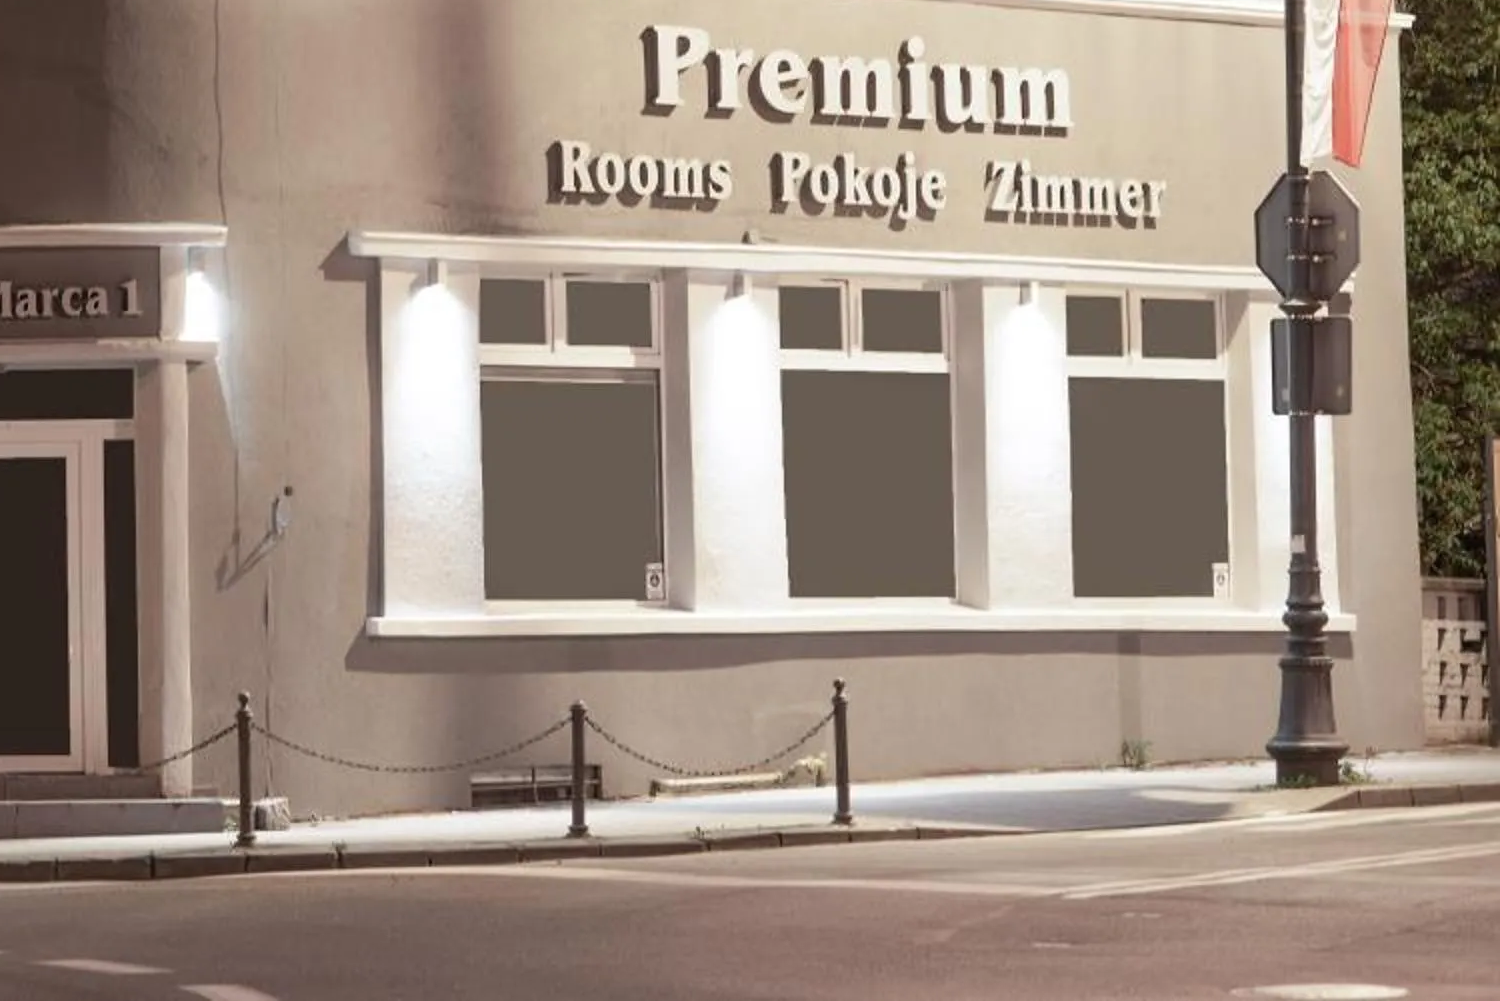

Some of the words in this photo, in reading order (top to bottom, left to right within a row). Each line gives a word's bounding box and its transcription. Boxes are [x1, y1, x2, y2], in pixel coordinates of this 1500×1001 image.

[647, 24, 1075, 129] Premium
[558, 139, 734, 200] Rooms
[777, 150, 948, 221] Pokoje
[990, 157, 1168, 220] Zimmer
[120, 278, 143, 317] 1
